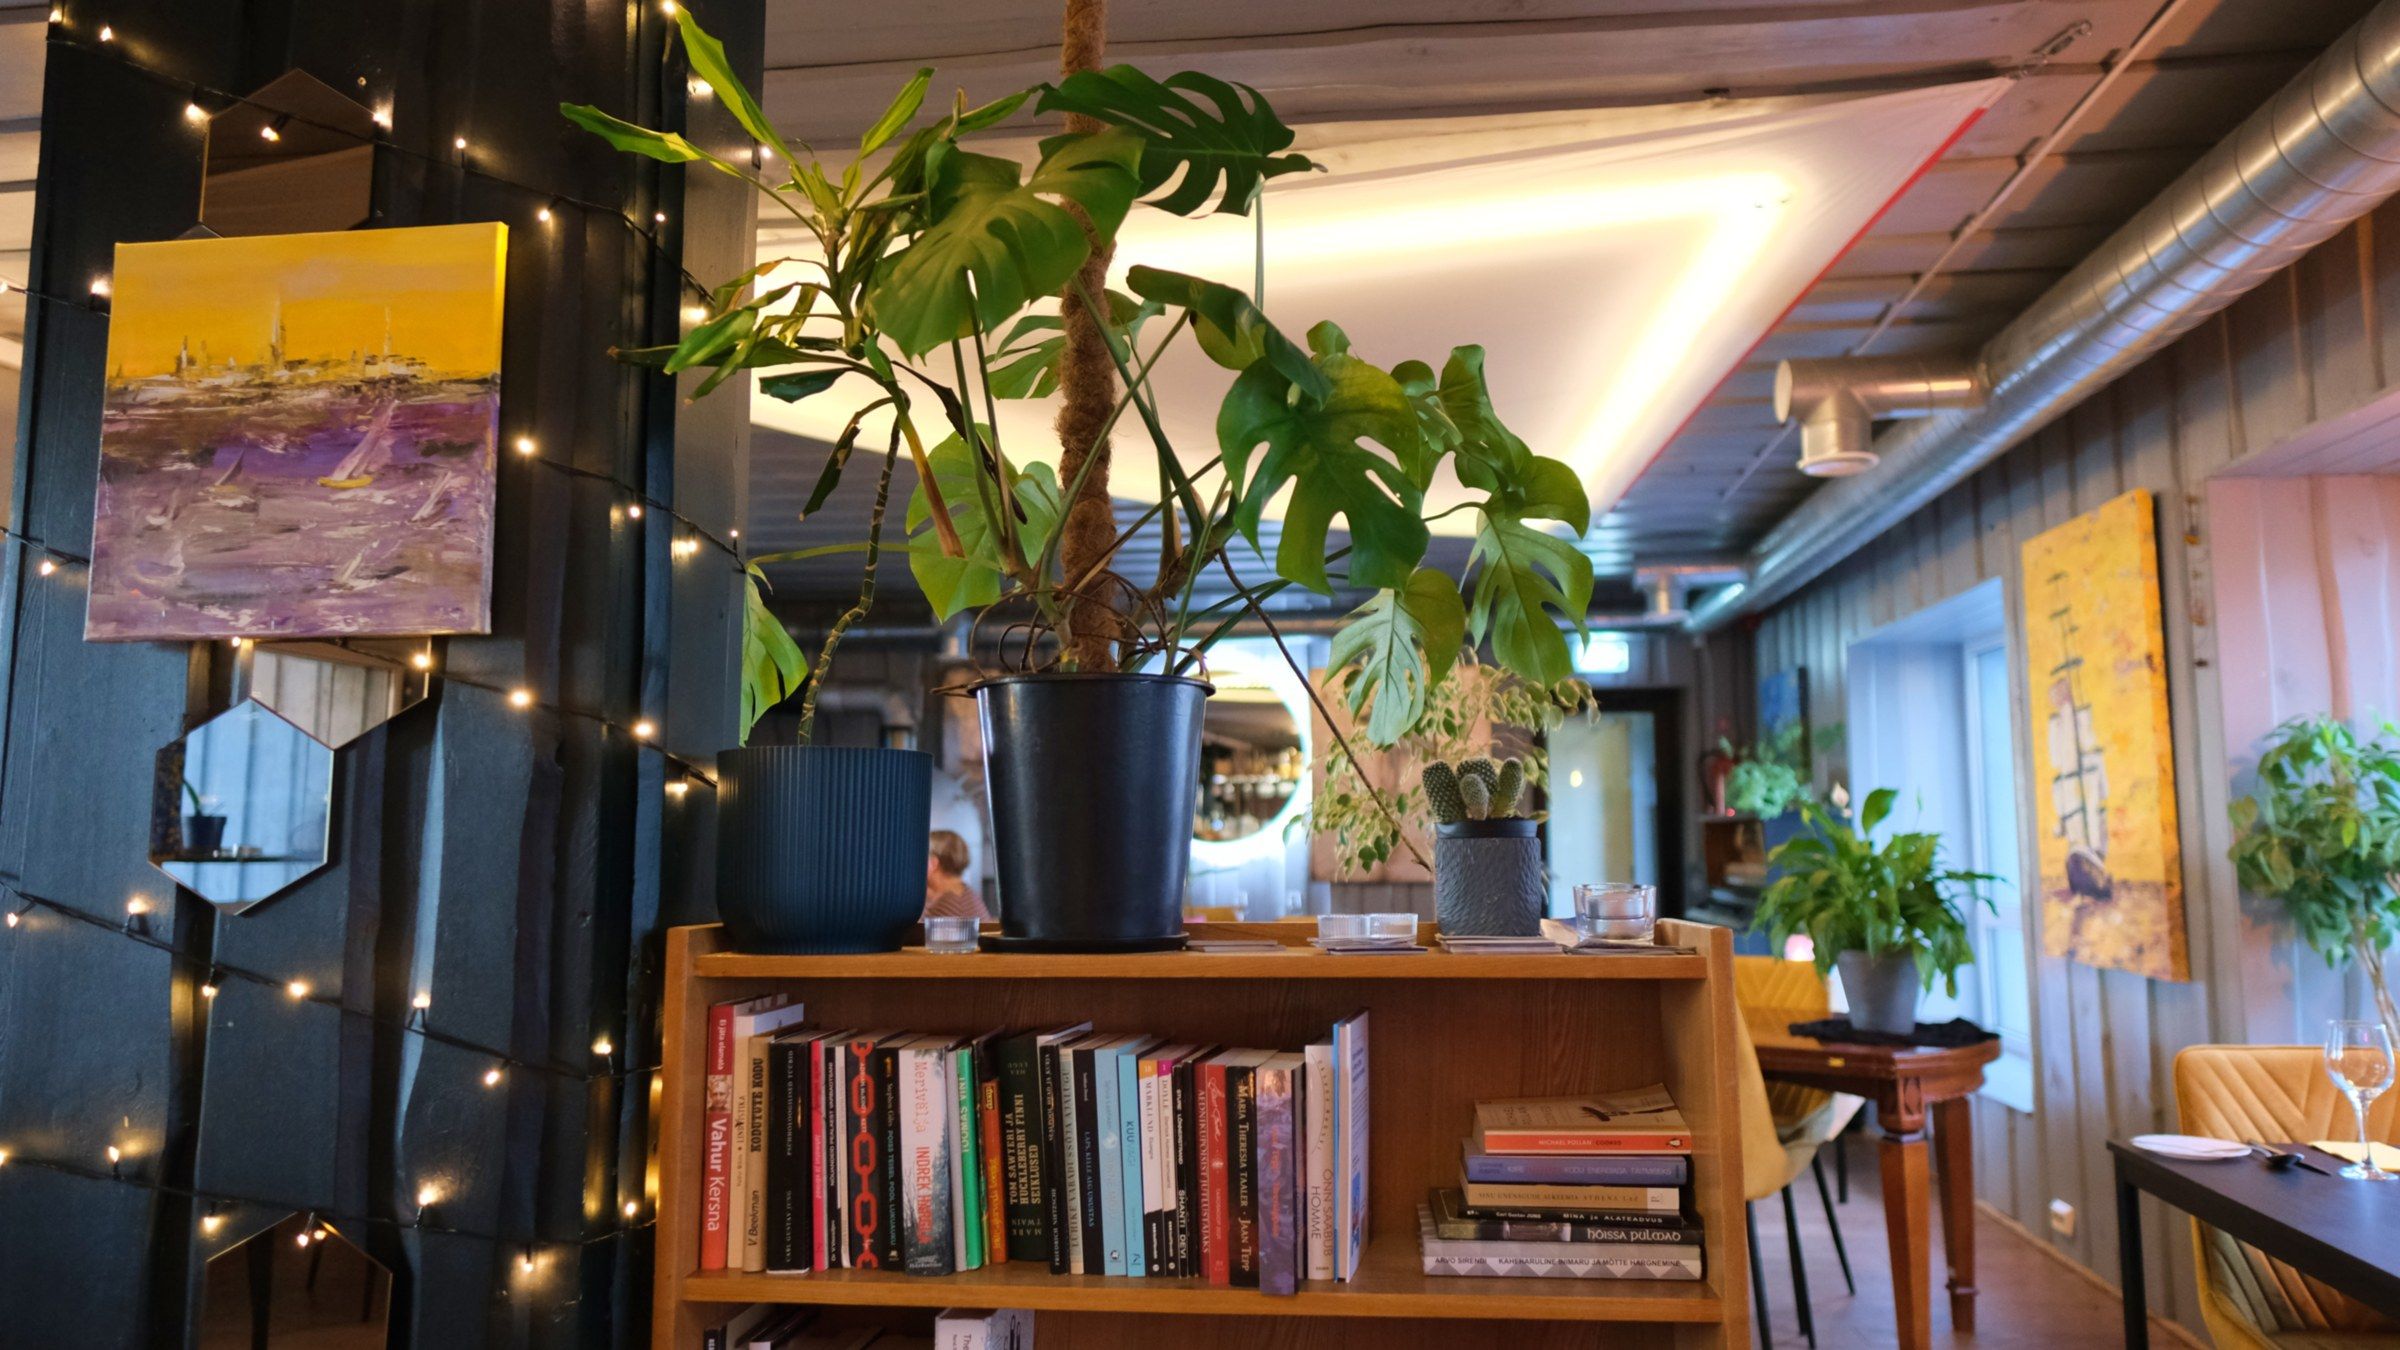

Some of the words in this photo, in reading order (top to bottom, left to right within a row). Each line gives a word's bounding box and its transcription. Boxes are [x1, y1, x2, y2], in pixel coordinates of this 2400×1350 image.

[752, 1058, 763, 1088] KODU
[913, 1061, 929, 1133] Merivälja
[1014, 1094, 1025, 1125] FINNI
[1238, 1085, 1248, 1119] MARIA
[750, 1092, 763, 1152] KODUTUTE
[1004, 1112, 1014, 1126] JA
[710, 1118, 727, 1172] Vahur
[1006, 1129, 1017, 1178] SAWYERI
[1239, 1122, 1249, 1168] THERESIA
[916, 1146, 931, 1190] INDREK
[1015, 1129, 1029, 1204] HUCKLEBERRY
[1029, 1145, 1041, 1204] SEIKLUSED
[708, 1176, 725, 1232] Kersna
[1009, 1182, 1018, 1204] TOM
[1178, 1189, 1186, 1228] SHANTI
[1240, 1171, 1249, 1207] TAALER
[749, 1190, 760, 1237] Beekman
[1087, 1191, 1095, 1227] UNUSTAS
[1311, 1186, 1321, 1239] HOMME
[1604, 1215, 1663, 1223] ALATEADVUS
[1238, 1217, 1251, 1243] JAAN
[1323, 1206, 1333, 1257] SAABUB
[1241, 1246, 1252, 1272] TEPP
[1458, 1257, 1487, 1265] SIRENDI
[1630, 1259, 1680, 1267] HARGNEMINE
